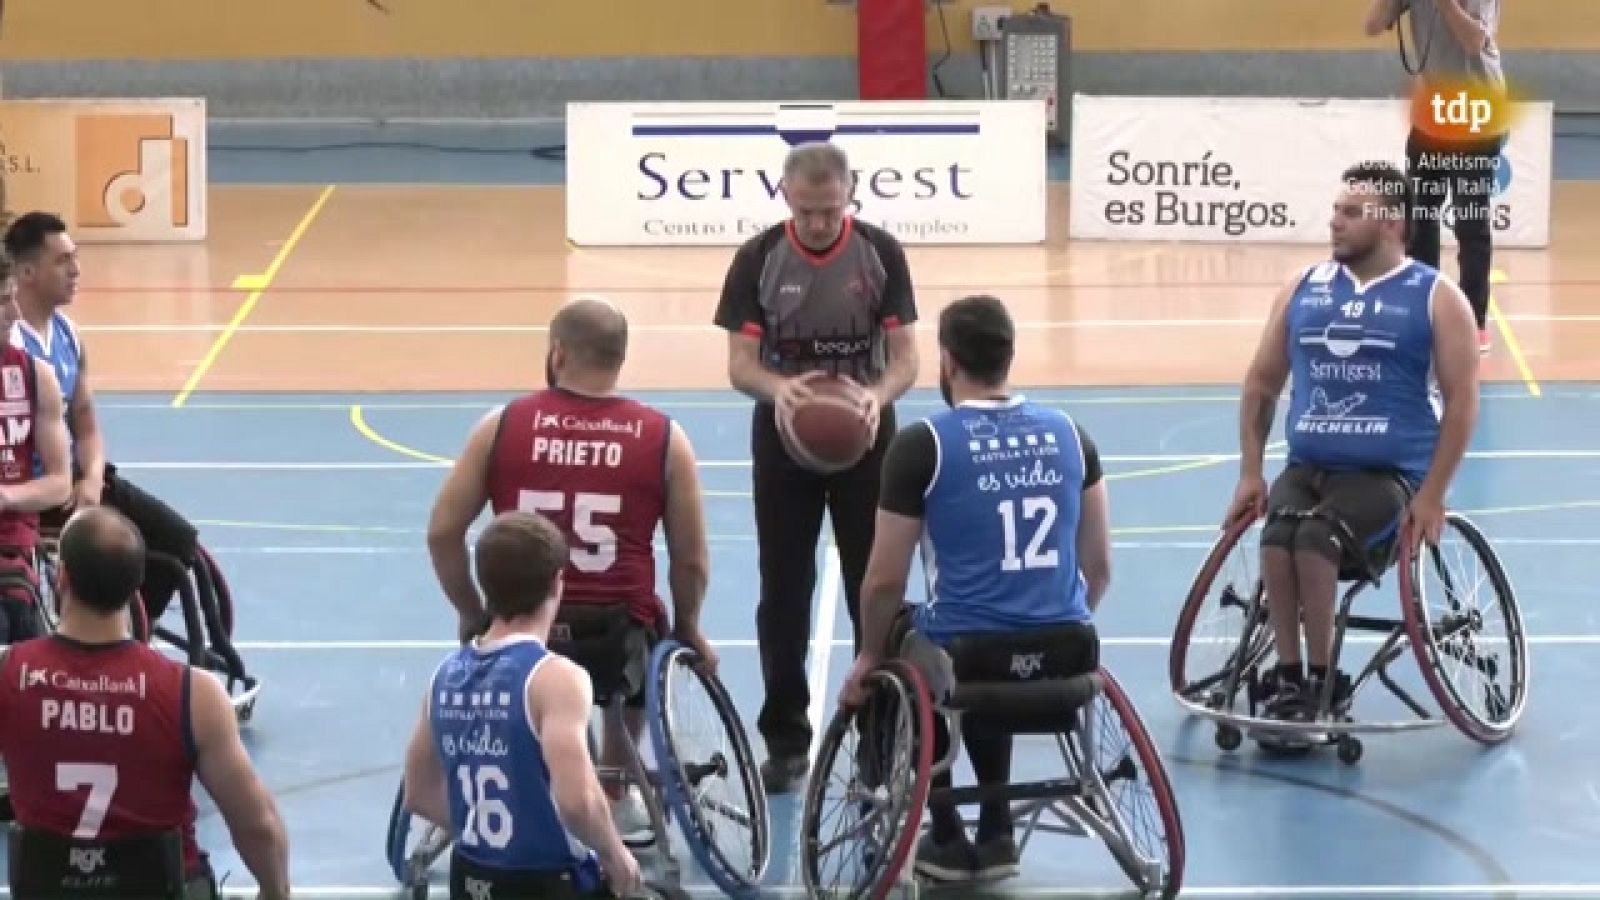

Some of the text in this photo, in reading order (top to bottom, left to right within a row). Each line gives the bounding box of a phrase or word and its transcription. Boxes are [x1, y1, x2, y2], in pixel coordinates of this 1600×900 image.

[637, 151, 975, 213] Servest
[1107, 150, 1241, 190] Sonríe,
[643, 219, 726, 236] Centro
[1104, 189, 1297, 236] es Burgos.
[562, 414, 634, 434] CaixaBank
[1295, 421, 1389, 434] MICHELIN
[532, 437, 622, 468] PRIETO
[977, 459, 1064, 491] es vida
[997, 497, 1059, 571] 12
[52, 669, 138, 693] CaixaBank
[41, 699, 135, 736] PABLO
[55, 762, 119, 839] 7
[457, 764, 514, 849] 16
